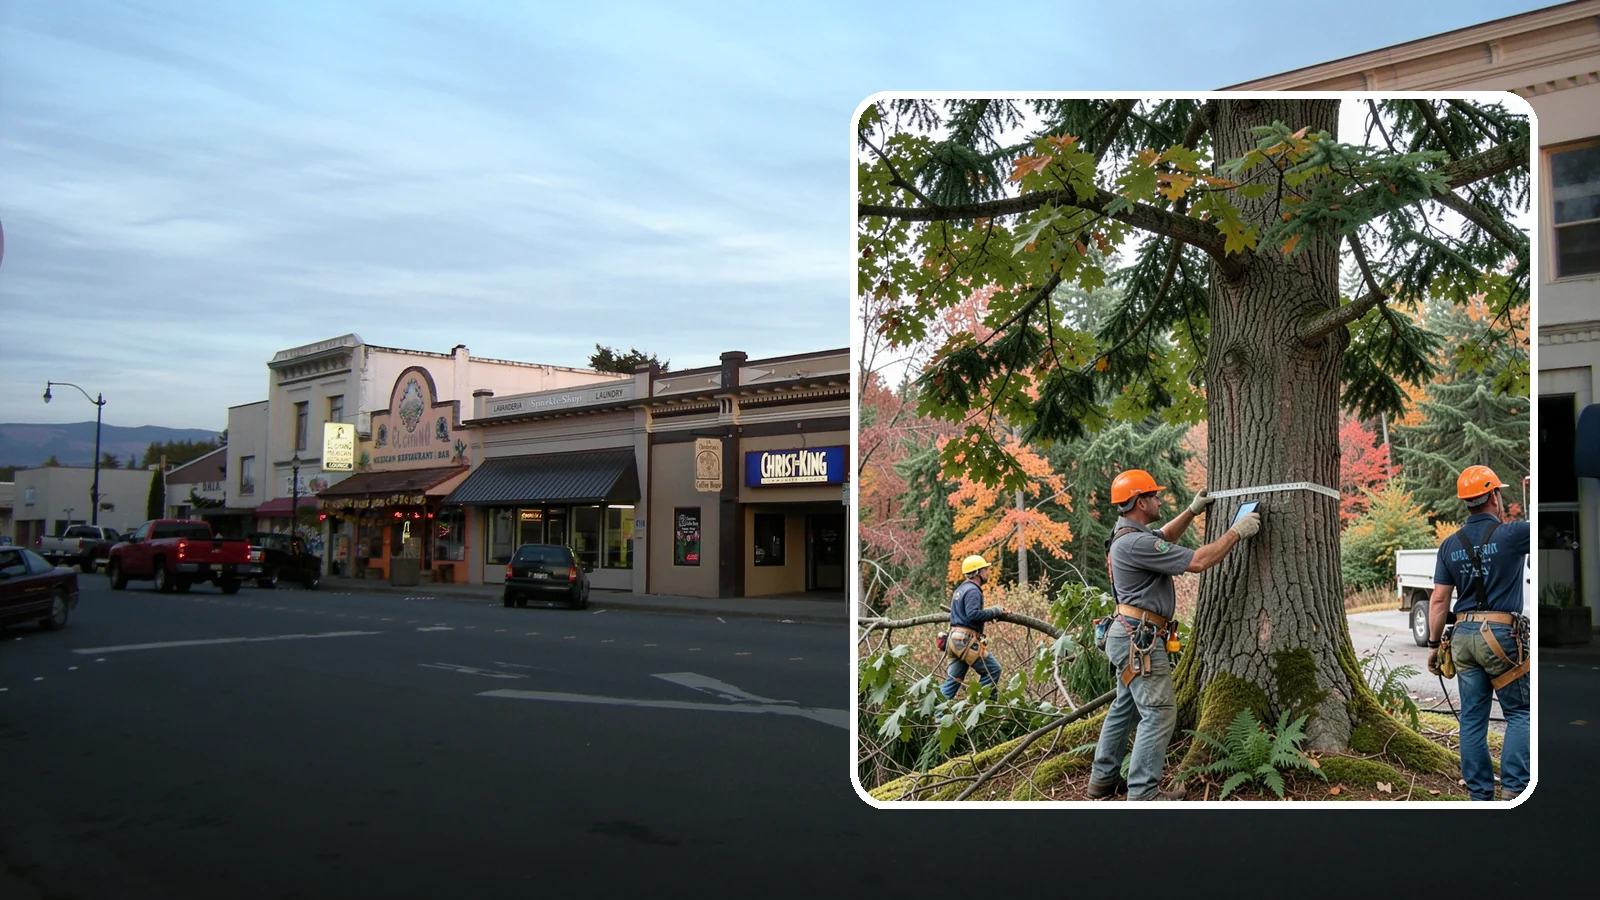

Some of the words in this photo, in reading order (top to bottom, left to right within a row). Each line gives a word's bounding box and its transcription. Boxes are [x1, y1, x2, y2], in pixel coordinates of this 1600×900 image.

[595, 389, 624, 400] LAUNDRY
[494, 402, 522, 413] LAVANDERIA
[530, 396, 561, 410] Sparkle
[562, 394, 583, 405] Shop
[373, 454, 396, 464] MEXICAN
[397, 451, 434, 462] RESTAURANT
[438, 450, 450, 459] BAR
[761, 452, 797, 478] CHRIST
[799, 450, 828, 476] KING
